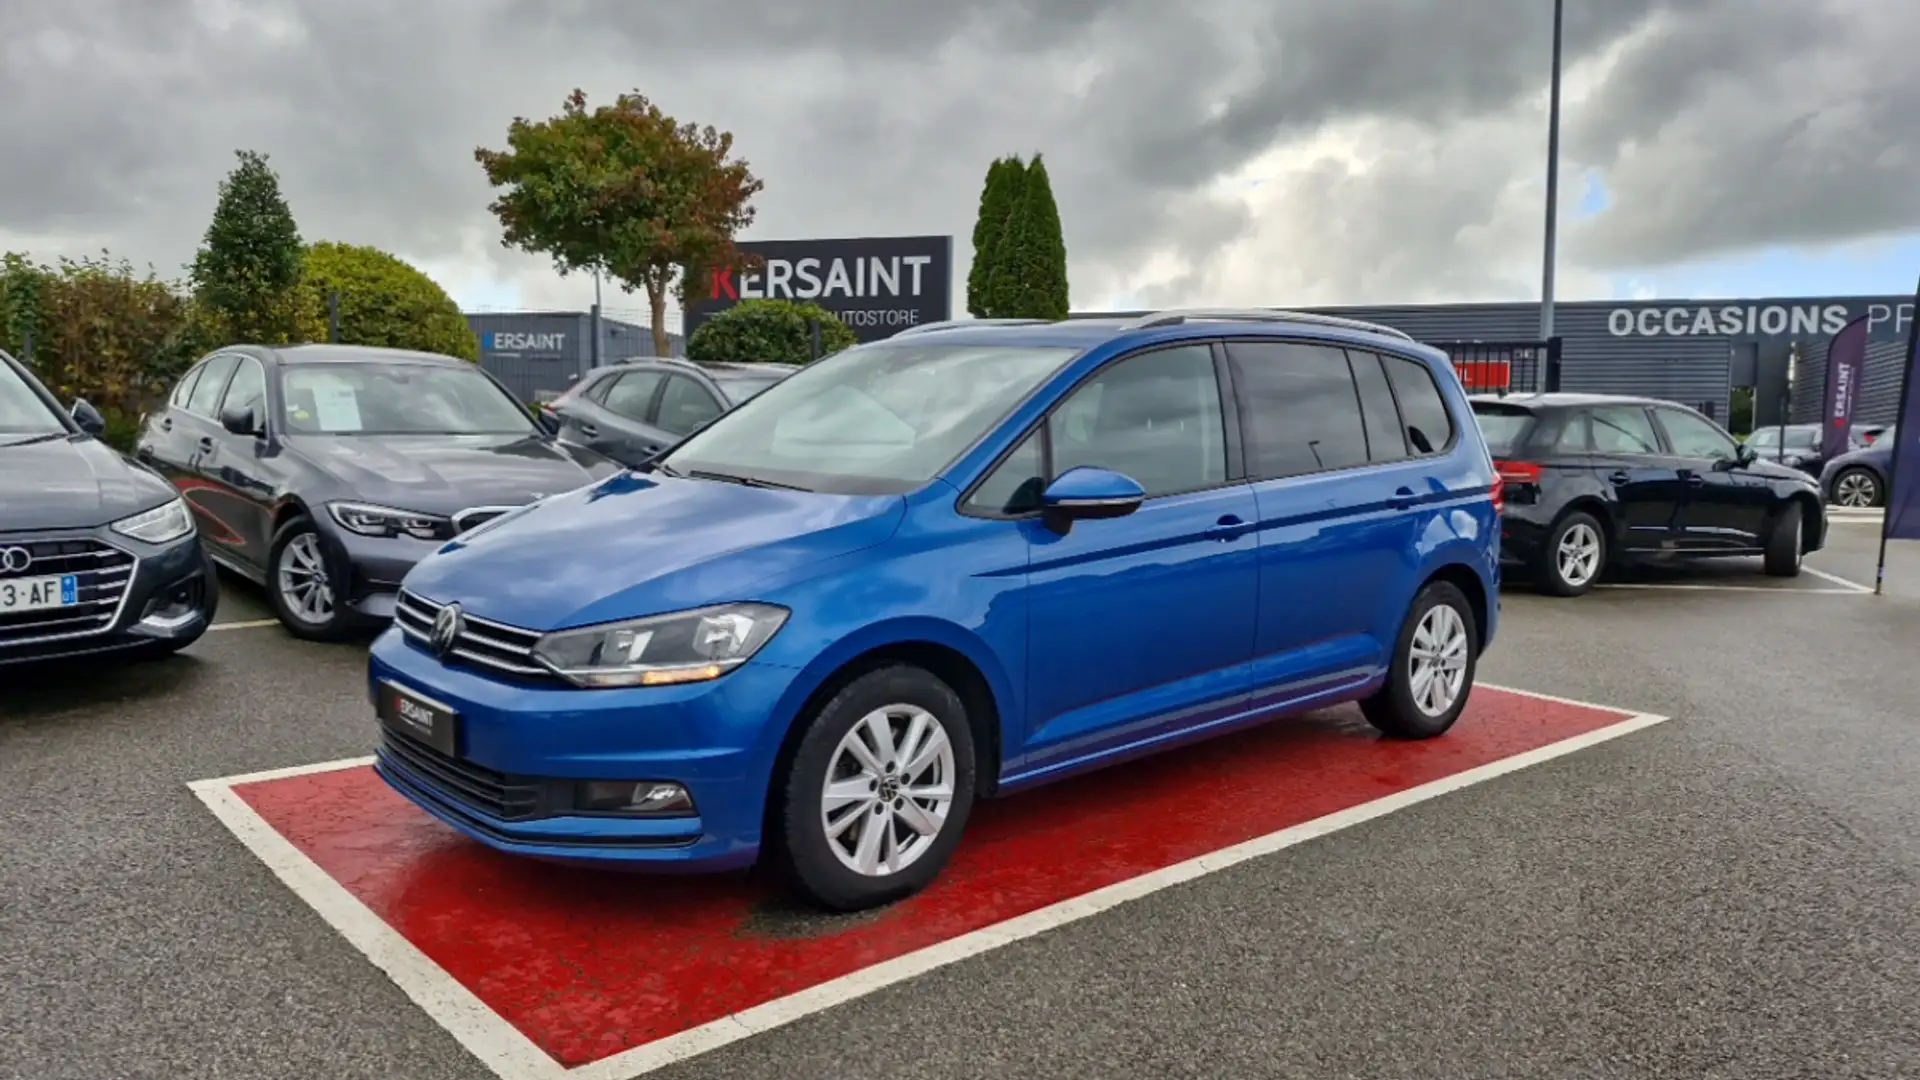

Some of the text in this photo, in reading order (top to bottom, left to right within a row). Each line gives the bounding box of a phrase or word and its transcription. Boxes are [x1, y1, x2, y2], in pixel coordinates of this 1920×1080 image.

[711, 256, 931, 299] KERSAINT
[833, 309, 919, 326] UTOSTORE
[1608, 305, 1848, 336] OCCASIONS
